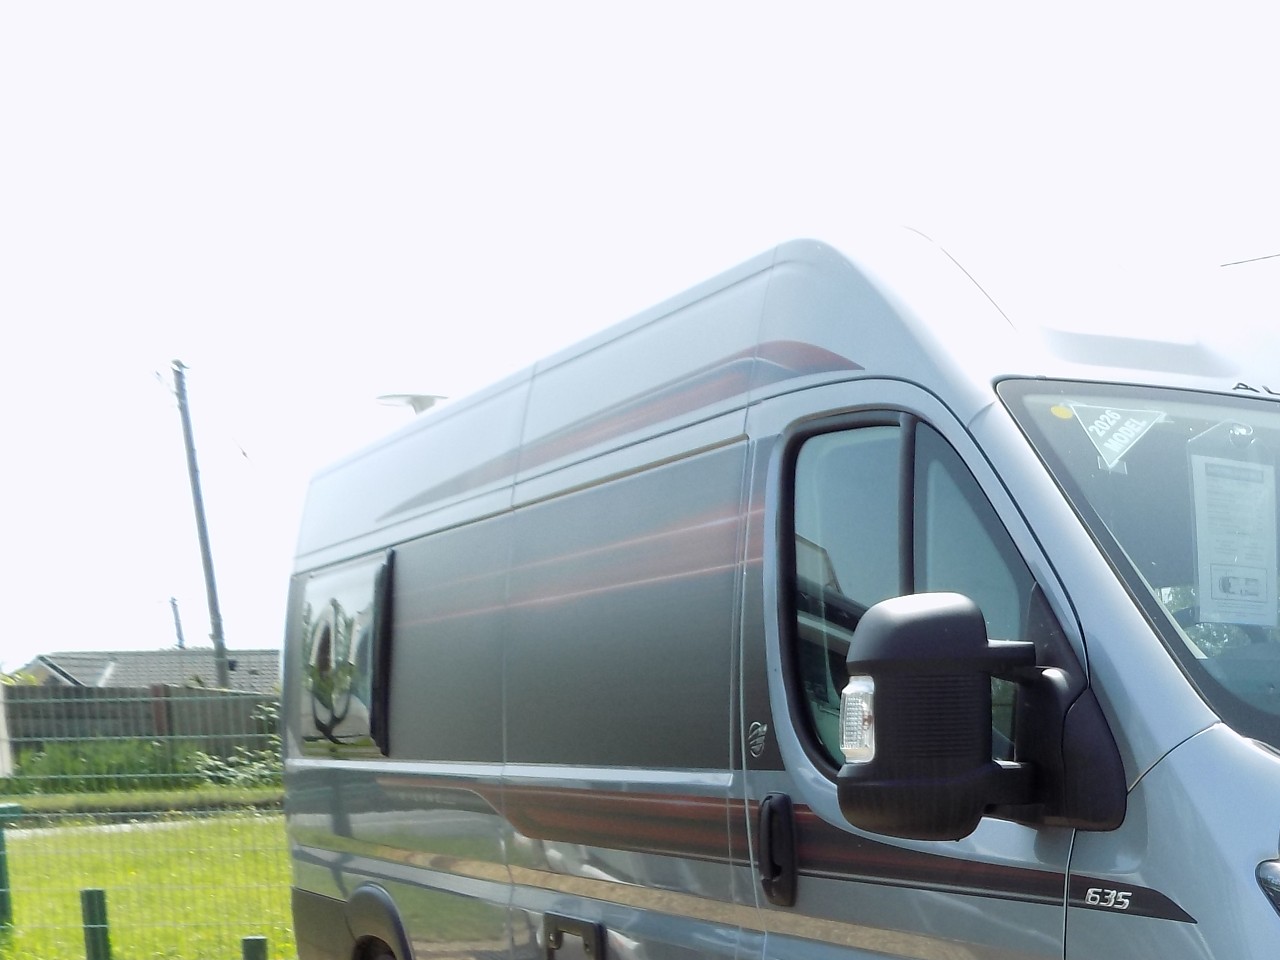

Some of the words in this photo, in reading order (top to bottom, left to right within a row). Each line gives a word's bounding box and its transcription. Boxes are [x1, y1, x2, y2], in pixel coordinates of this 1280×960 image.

[1088, 408, 1122, 438] 2026
[1103, 417, 1148, 453] MODEL
[1085, 887, 1133, 910] 635
